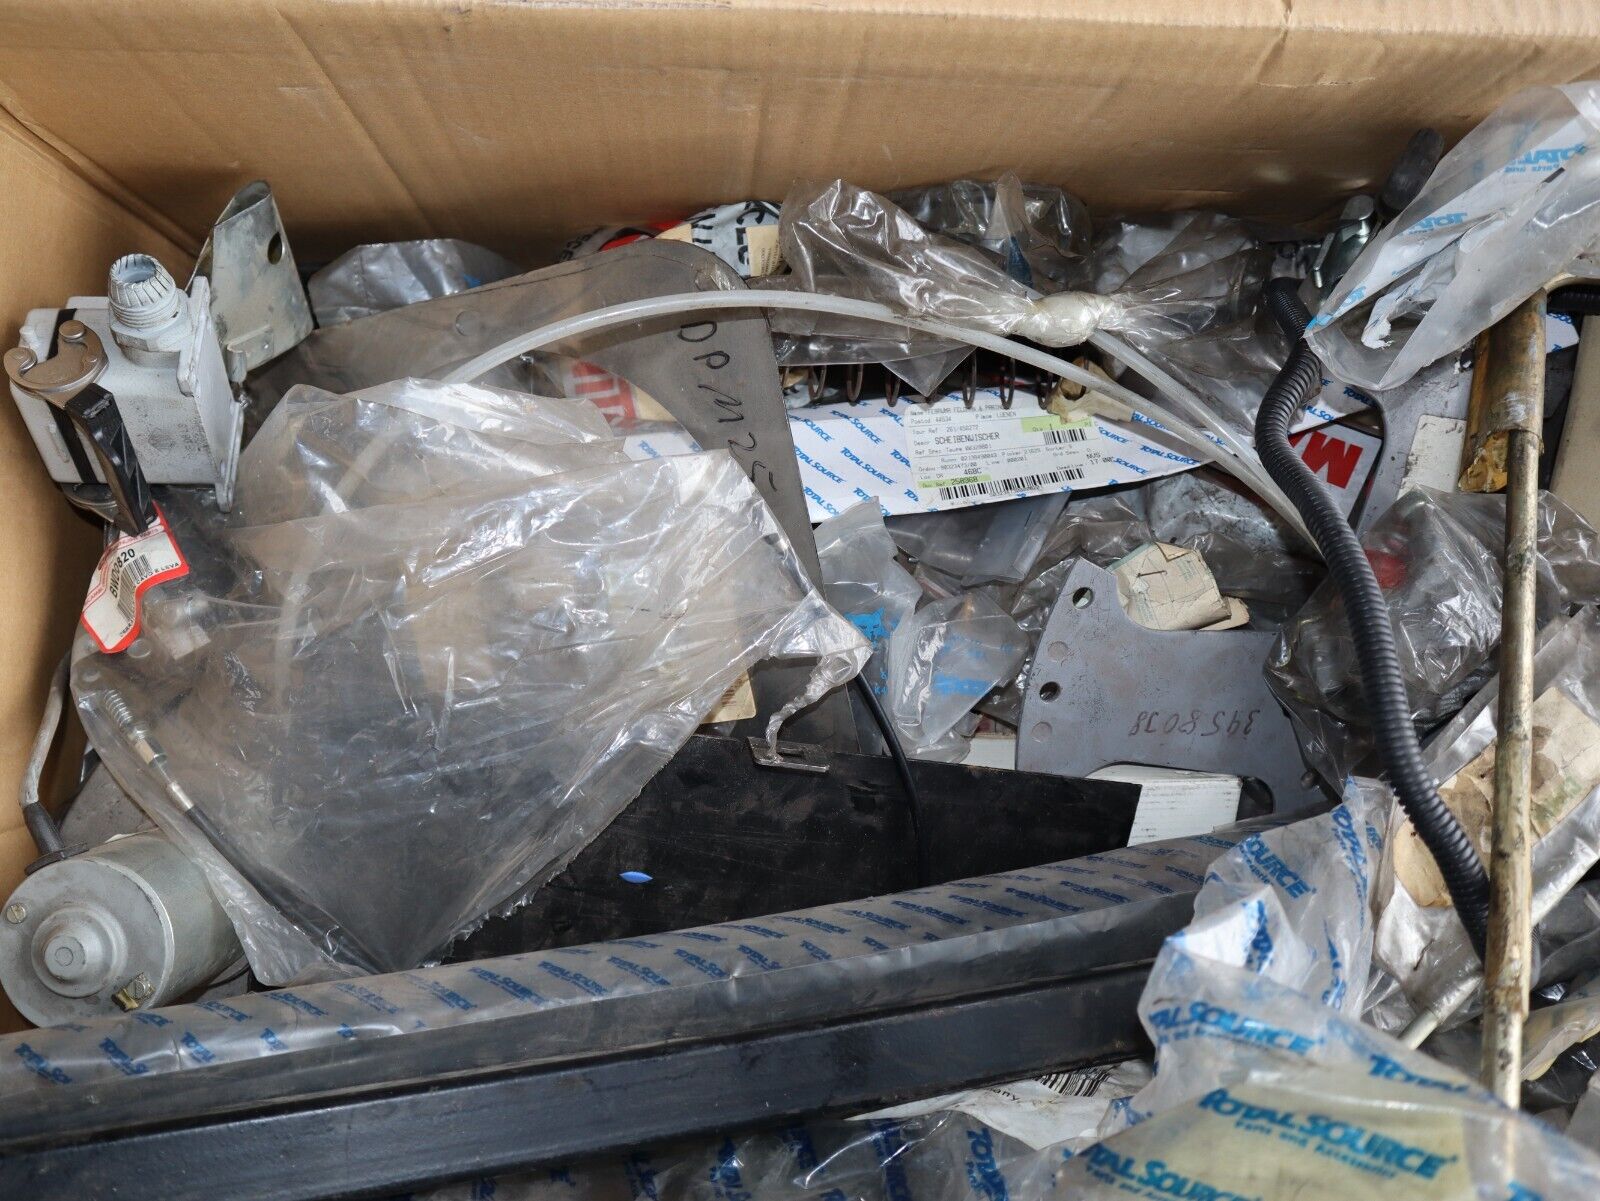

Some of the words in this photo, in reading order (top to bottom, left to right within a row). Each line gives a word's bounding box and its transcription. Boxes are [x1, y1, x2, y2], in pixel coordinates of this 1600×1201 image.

[934, 432, 1000, 446] SCHEIBENWISCHER
[841, 447, 896, 486] TOTALSOURCE
[1139, 444, 1200, 466] TOTALSOURCE
[1198, 1086, 1459, 1181] TOTALSOURCE
